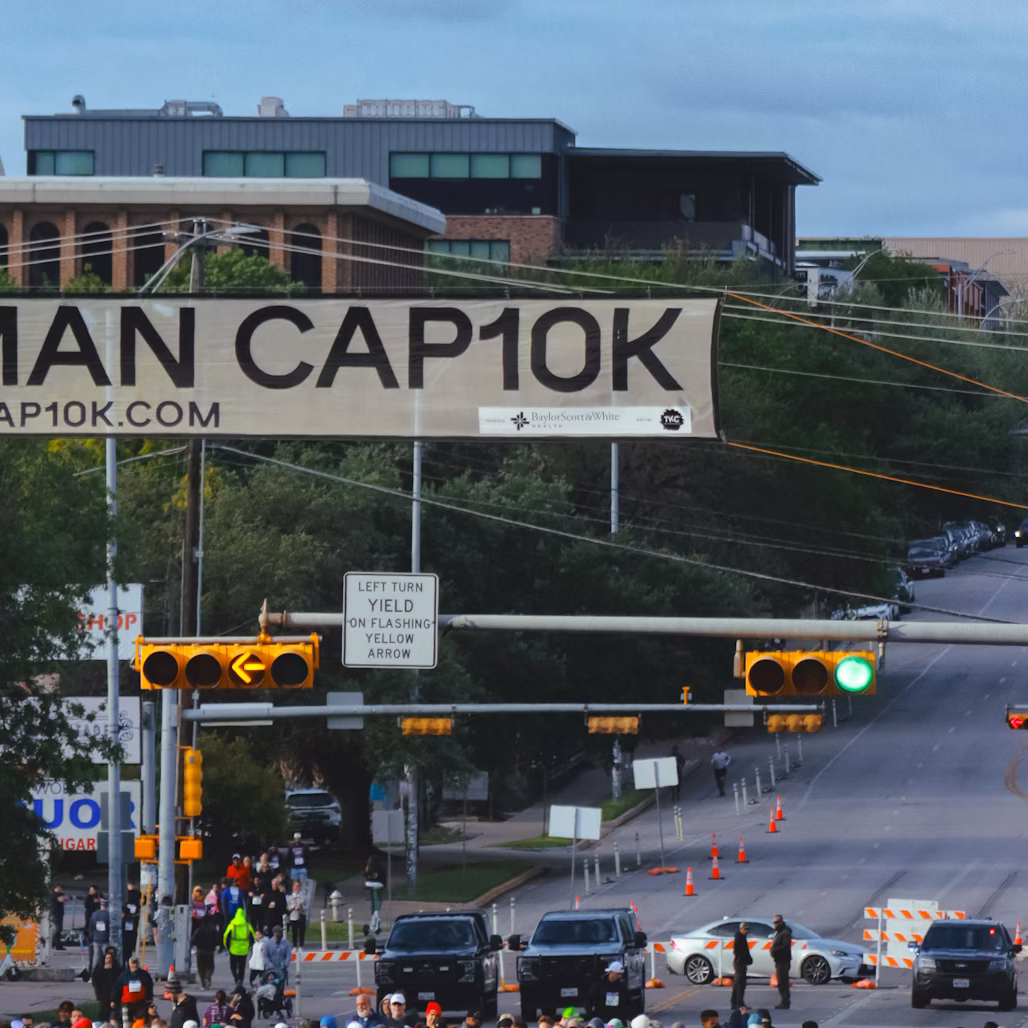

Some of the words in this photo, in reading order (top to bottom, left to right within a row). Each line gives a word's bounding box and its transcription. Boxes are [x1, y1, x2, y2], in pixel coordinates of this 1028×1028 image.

[235, 304, 684, 393] CAP10K
[358, 581, 387, 592] LEFT
[391, 582, 423, 593] TURN
[367, 598, 414, 613] YIELD
[349, 617, 366, 628] ON
[370, 617, 431, 629] FLASHING
[365, 632, 414, 644] YELLOW
[367, 648, 411, 659] ARROW
